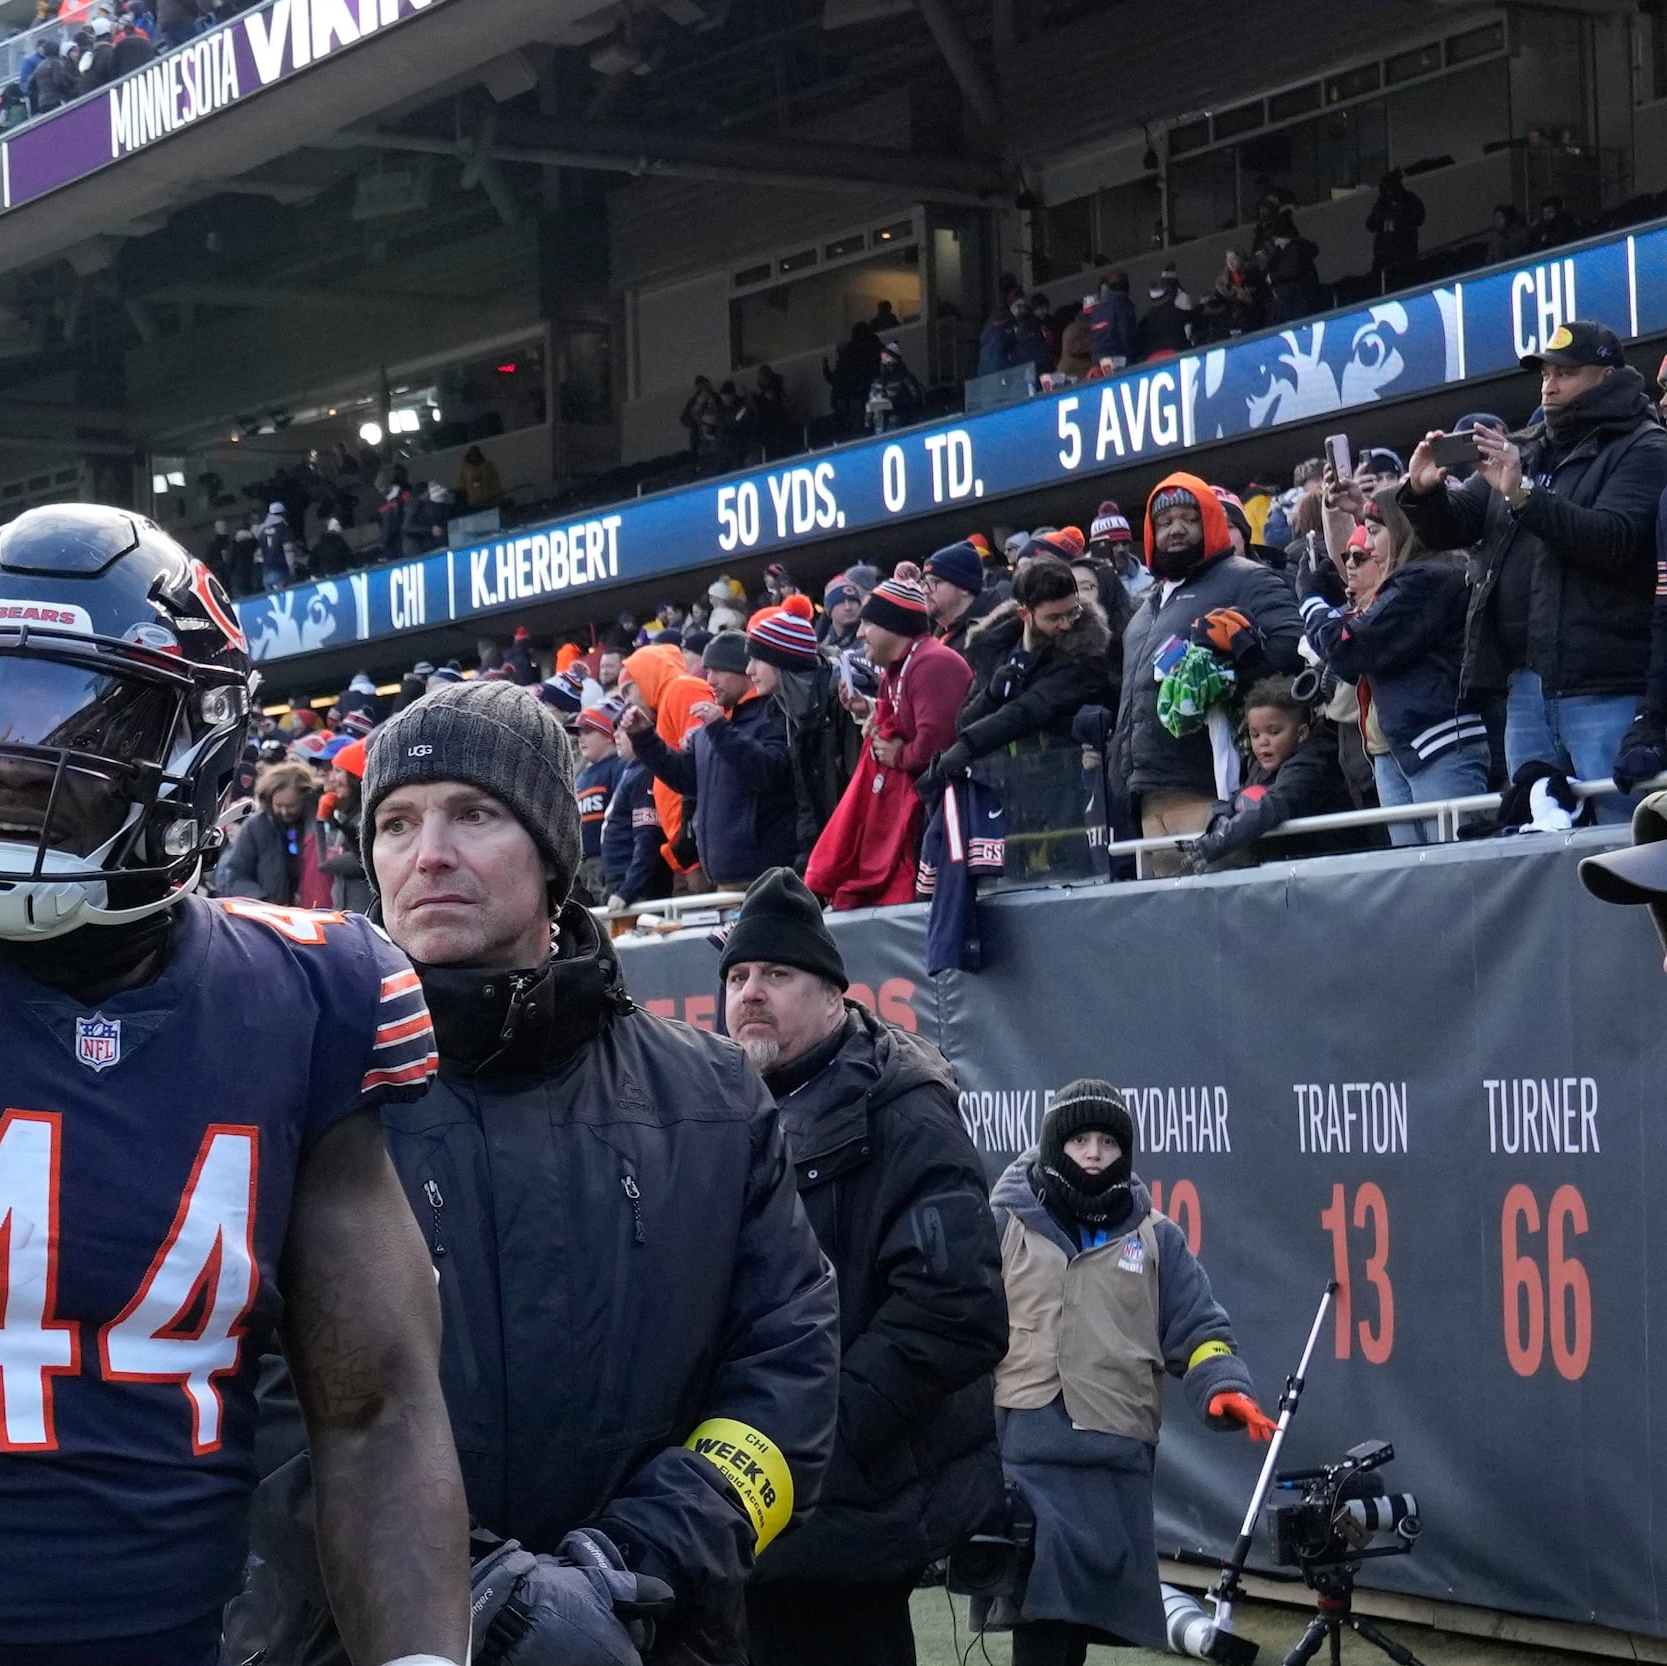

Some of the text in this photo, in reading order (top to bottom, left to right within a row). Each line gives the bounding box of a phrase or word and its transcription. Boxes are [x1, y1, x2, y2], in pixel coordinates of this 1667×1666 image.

[110, 28, 239, 158] MINNESOTA
[1511, 257, 1579, 360] CHI
[390, 562, 426, 631] CHI
[470, 515, 622, 609] K.HERBERT
[717, 481, 760, 551] 50
[881, 445, 907, 514] 0
[1057, 397, 1083, 470] 5
[1096, 363, 1179, 463] AVG
[407, 743, 433, 757] UGG
[82, 1037, 114, 1062] NFL
[1293, 1082, 1408, 1154] TRAFTON
[1483, 1077, 1601, 1154] TURNER
[1321, 1181, 1395, 1365] 13
[1501, 1183, 1593, 1381] 66
[694, 1437, 777, 1509] WEEK 18
[744, 1432, 769, 1454] CHI
[743, 1489, 765, 1529] Access
